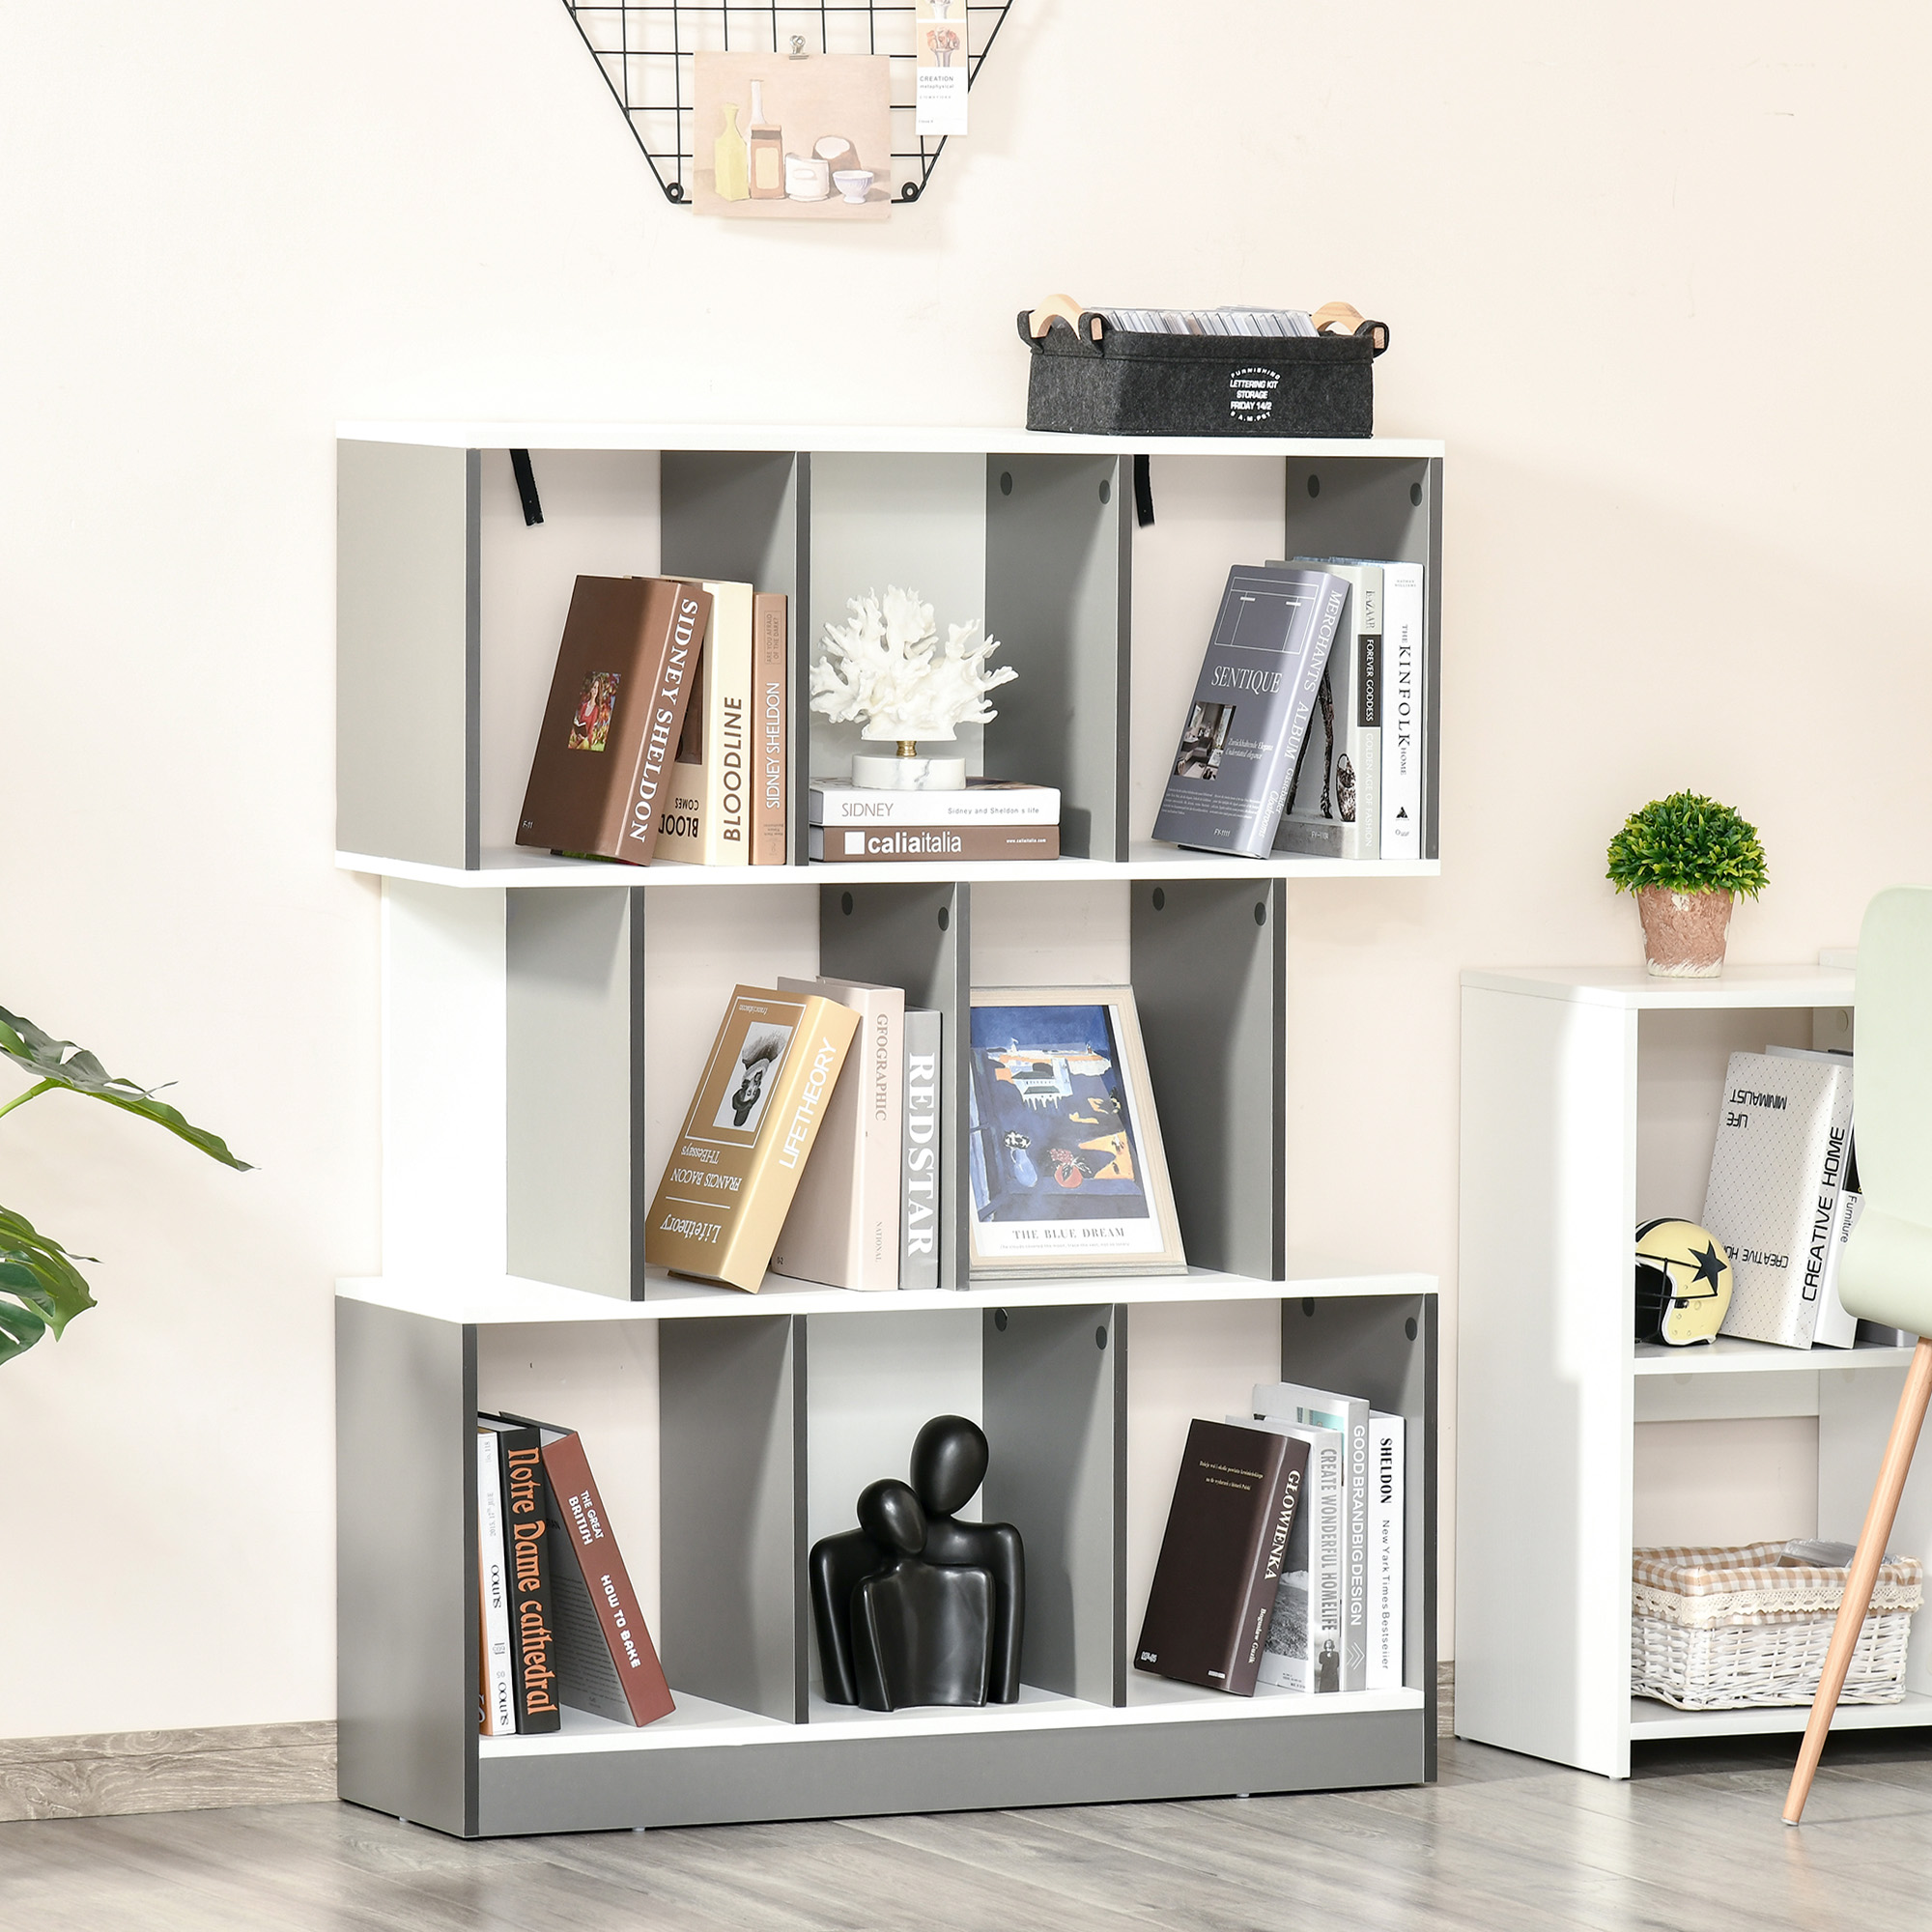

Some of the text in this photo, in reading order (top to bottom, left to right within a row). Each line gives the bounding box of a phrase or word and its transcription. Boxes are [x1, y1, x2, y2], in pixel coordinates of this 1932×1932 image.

[1229, 379, 1279, 389] LETTERING KIT
[1230, 401, 1272, 410] FRIDAY 14/2
[1236, 390, 1268, 399] STORAGE
[1211, 665, 1282, 695] SENTIQUE
[1285, 590, 1342, 760] MERCHANTS ALBUM
[1365, 639, 1374, 722] FOREVER GODDESS
[1398, 644, 1411, 747] KINFOLK
[629, 598, 699, 843] SIDNEY SHELDON
[766, 682, 780, 754] SHELDON
[724, 697, 742, 841] BLOODLINE
[766, 755, 780, 810] SIDNEY
[675, 797, 699, 810] COMES
[842, 803, 894, 817] SIDNEY
[948, 807, 972, 816] Sidney
[1365, 791, 1373, 803] OF
[867, 831, 962, 854] caliaitalia
[779, 1037, 837, 1169] LIFETHEORY
[1726, 1112, 1747, 1128] LIFE
[1730, 1088, 1788, 1110] MINIMALIST
[681, 1143, 720, 1164] THEessays
[908, 1052, 935, 1257] REDSTAR
[670, 1168, 741, 1192] FRANCIS BACON
[660, 1214, 722, 1244] Lifetheory
[1012, 1228, 1125, 1240] THE BLUE DREAM
[1802, 1126, 1845, 1302] CREATIVE HOME
[1743, 1248, 1789, 1268] CREATIVE
[1353, 1424, 1365, 1475] GOOD
[1380, 1437, 1392, 1504] SHELDON
[567, 1495, 593, 1546] BRITISH
[580, 1490, 605, 1540] THE GREAT
[1265, 1469, 1301, 1579] GŁOWIENKA
[1321, 1448, 1337, 1631] CREATE WONDERFUL HOMELIFE
[1382, 1520, 1390, 1543] New
[508, 1447, 558, 1716] Notre Dame cathedral
[1351, 1563, 1363, 1626] DESIGN
[1381, 1575, 1390, 1608] Times
[600, 1574, 641, 1669] HOW TO BAKE
